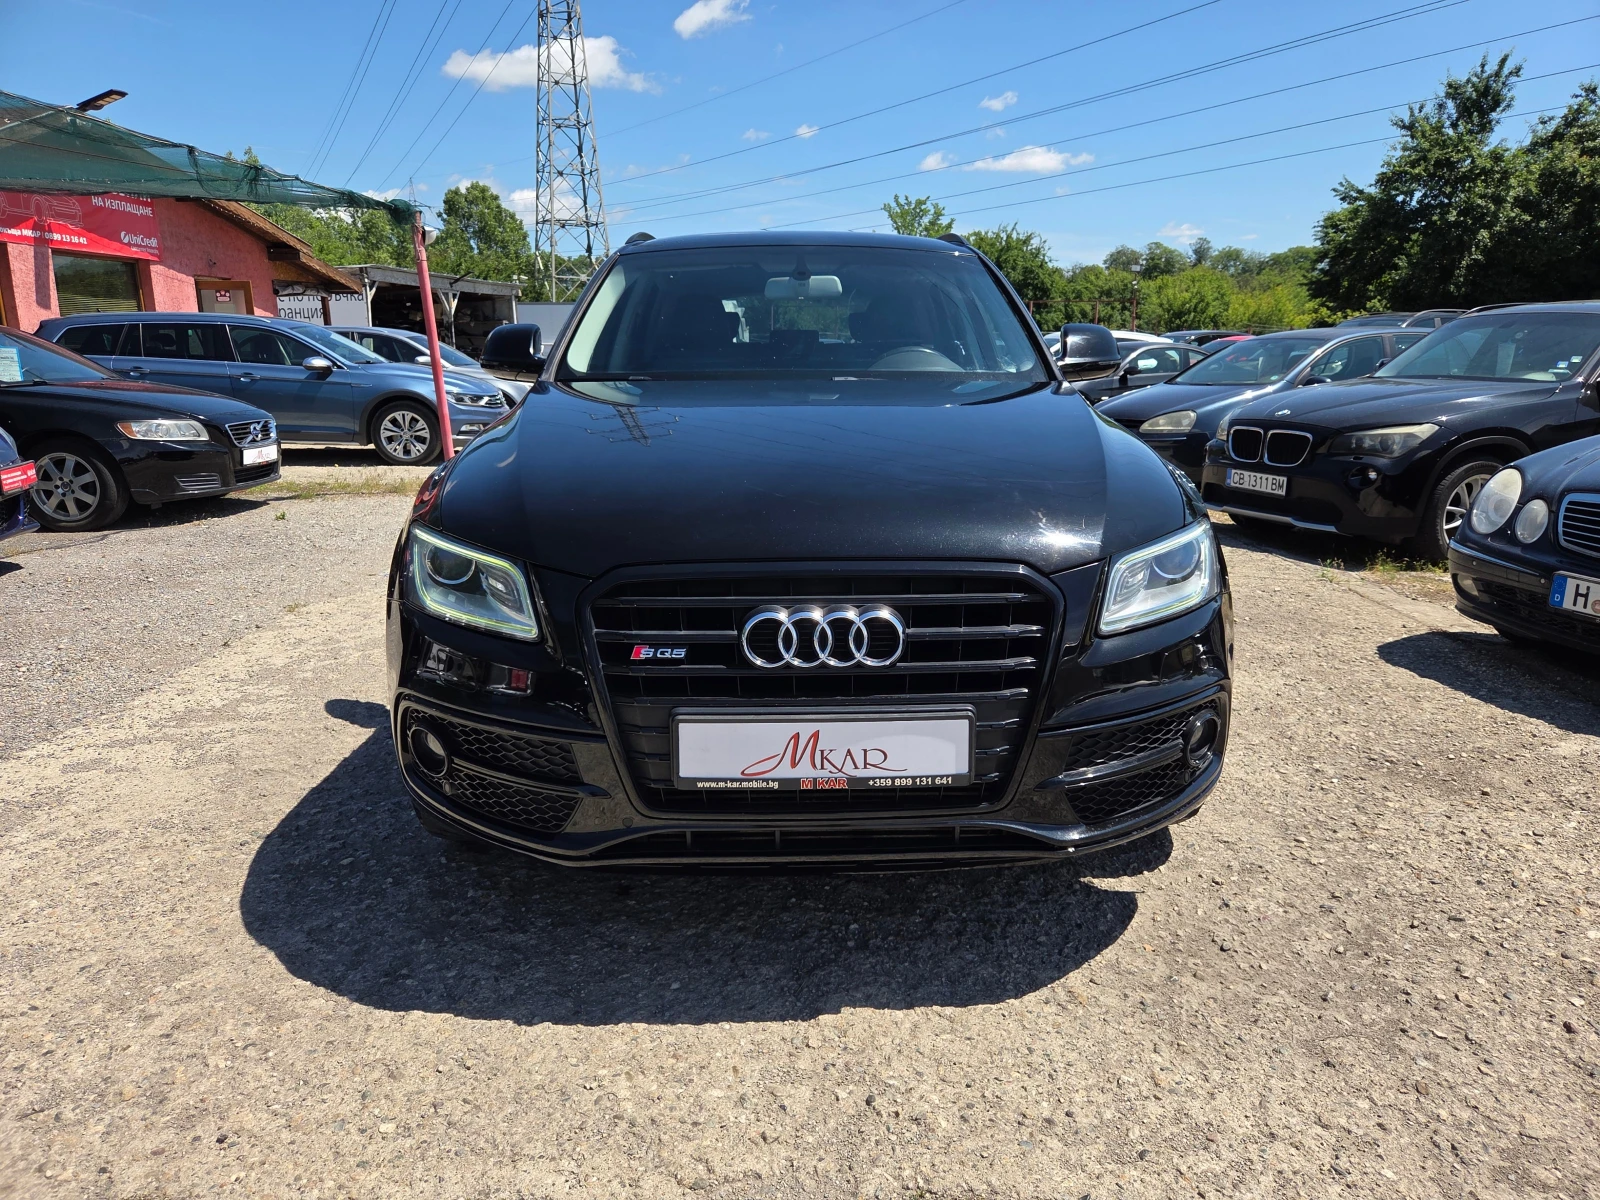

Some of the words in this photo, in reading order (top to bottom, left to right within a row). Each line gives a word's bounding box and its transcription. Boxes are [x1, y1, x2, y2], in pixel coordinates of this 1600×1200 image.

[91, 195, 104, 207] НА
[105, 198, 153, 217] ИЗПЛАЩАНЕ
[22, 228, 41, 237] МКАР
[45, 232, 62, 240] 0899
[62, 234, 70, 242] 13
[129, 233, 157, 247] UniCredit
[1554, 594, 1561, 602] D
[1572, 583, 1591, 609] H
[696, 780, 779, 789] www.m-kar.mobile.bg
[800, 778, 813, 790] M
[816, 778, 848, 790] KAR
[868, 778, 892, 787] +359
[894, 778, 913, 786] 899
[915, 777, 932, 785] 131
[935, 776, 952, 785] 641
